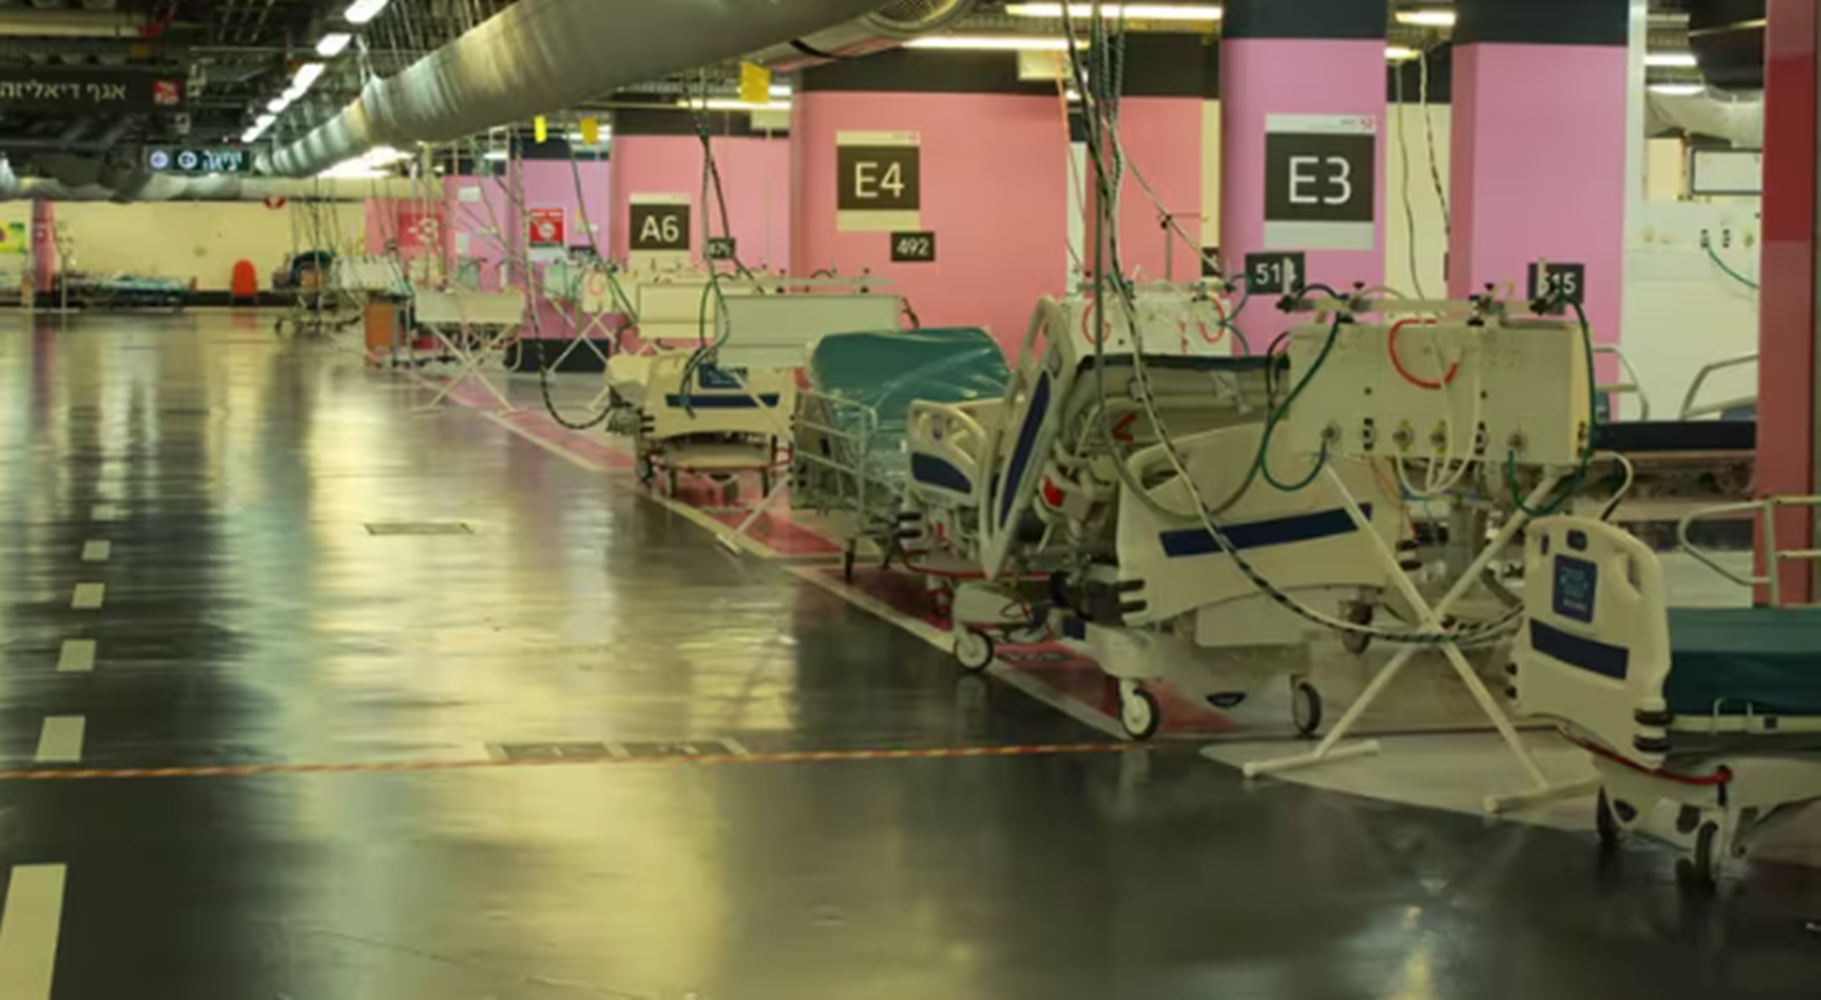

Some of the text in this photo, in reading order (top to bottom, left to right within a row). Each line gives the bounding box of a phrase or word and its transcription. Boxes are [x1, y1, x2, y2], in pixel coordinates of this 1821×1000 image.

[0, 79, 126, 102] אגף דיאליזה
[855, 161, 905, 198] E4
[1289, 156, 1352, 204] E3
[640, 214, 679, 243] A6
[897, 238, 929, 256] 492
